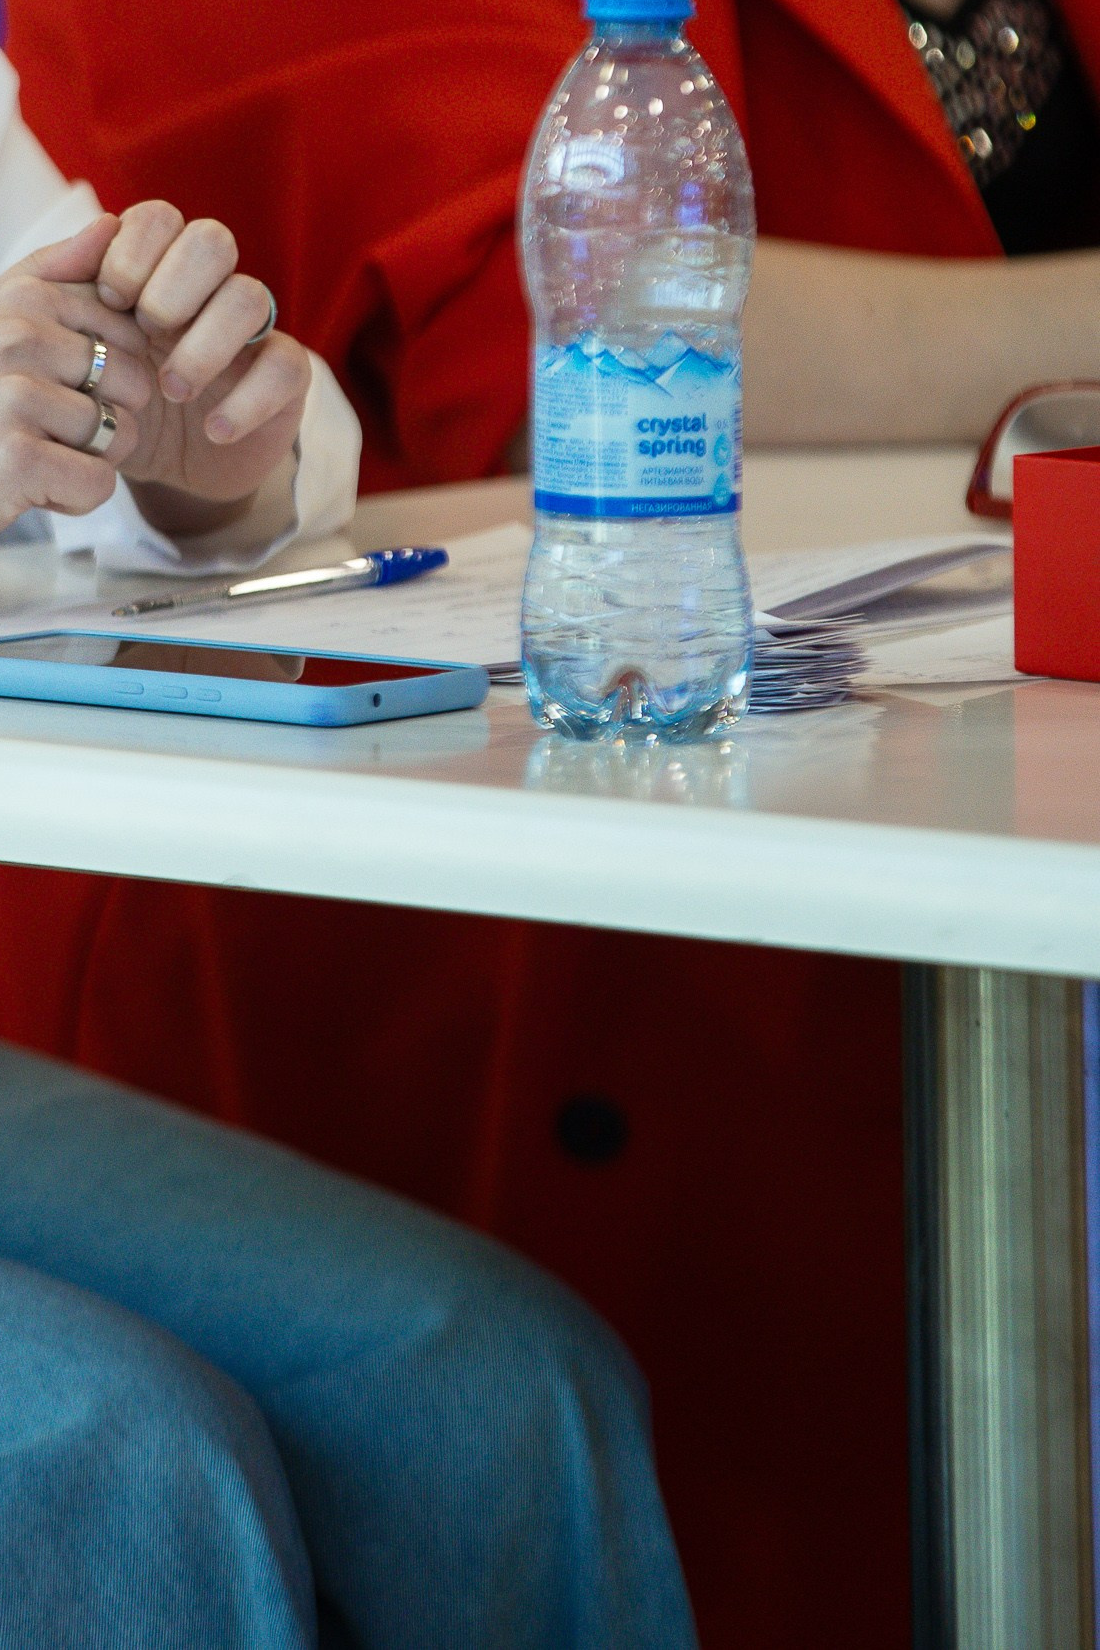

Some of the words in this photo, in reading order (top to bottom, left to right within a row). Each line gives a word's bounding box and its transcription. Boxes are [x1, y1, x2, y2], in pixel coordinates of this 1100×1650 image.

[637, 412, 708, 436] crystal
[638, 435, 706, 457] spring
[631, 502, 713, 513] НЕГАЗИРОВАННАЯ
